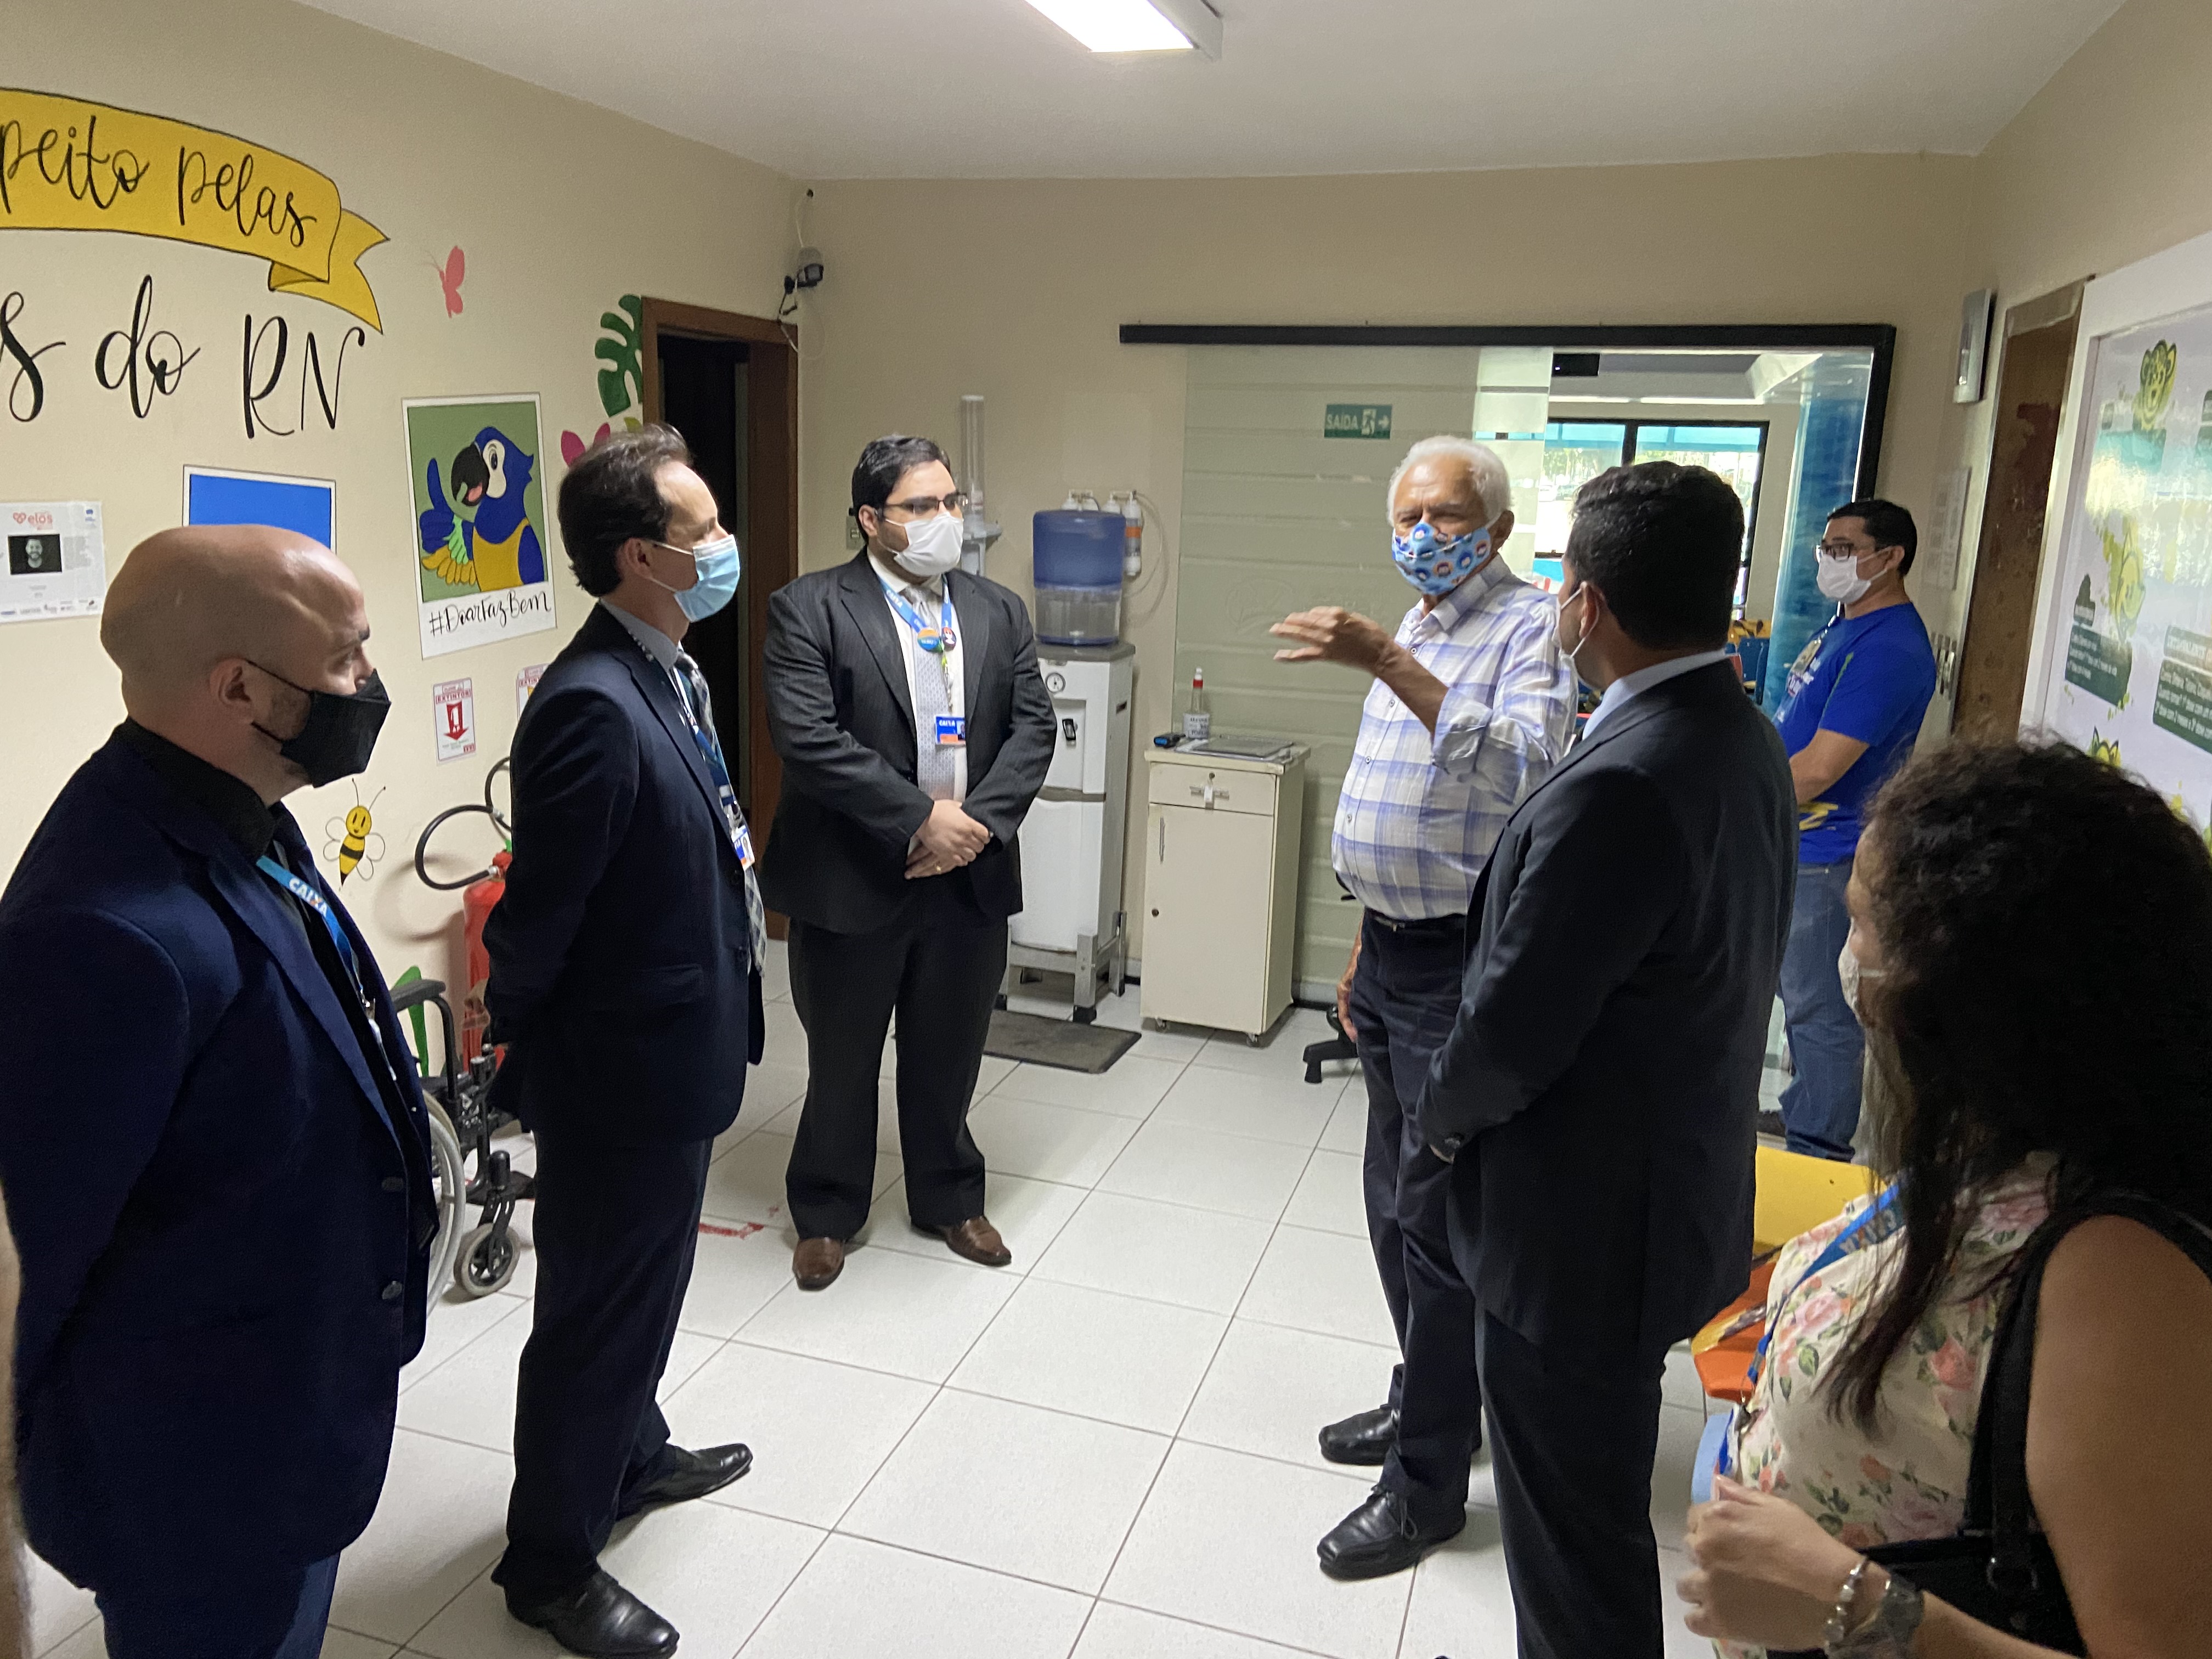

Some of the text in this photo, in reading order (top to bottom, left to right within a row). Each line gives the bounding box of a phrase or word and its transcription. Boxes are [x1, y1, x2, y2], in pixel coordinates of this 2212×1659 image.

[178, 146, 317, 247] pelas
[95, 275, 201, 418] do
[244, 314, 365, 439] RN
[289, 877, 328, 918] CAIXA
